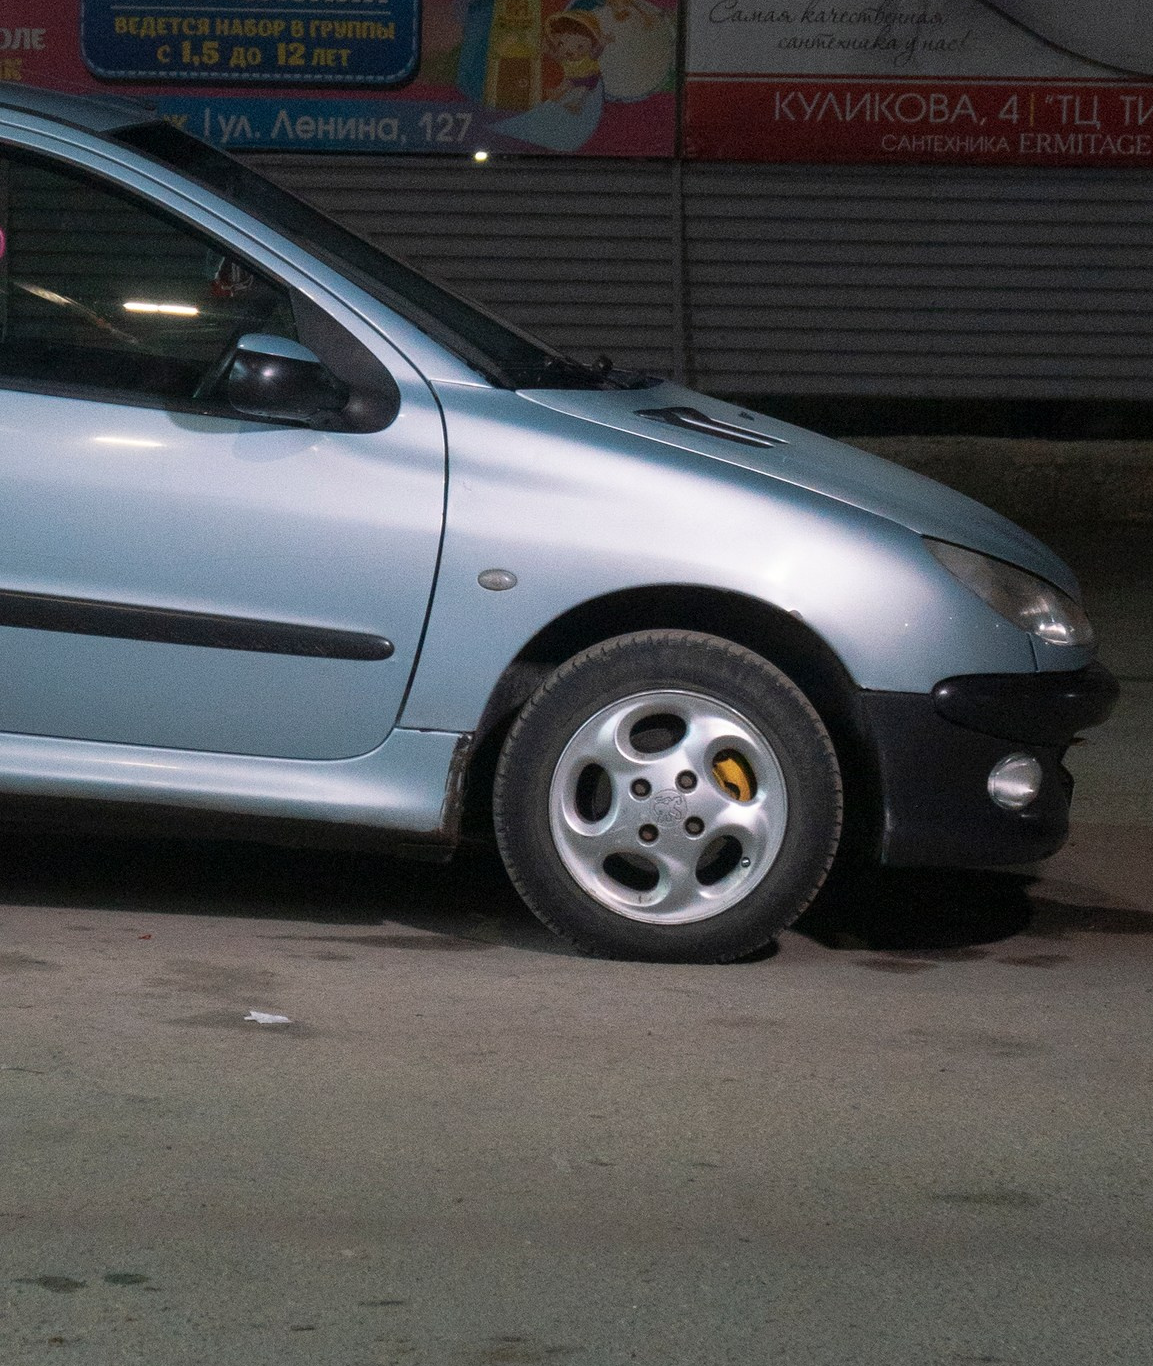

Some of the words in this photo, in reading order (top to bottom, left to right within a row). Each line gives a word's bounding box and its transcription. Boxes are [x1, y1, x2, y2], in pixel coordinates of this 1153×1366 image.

[114, 16, 211, 38] ВЕДЕТСЯ
[215, 18, 286, 37] НАБОР
[290, 19, 305, 37] В
[309, 20, 397, 40] ГРУППЫ
[181, 40, 221, 66] 1,5
[276, 41, 306, 66] 12
[777, 24, 897, 51] сантехника
[893, 34, 919, 68] у
[921, 29, 973, 53] нас!
[773, 91, 987, 126] КУЛИКОВА,
[996, 93, 1020, 124] 4
[217, 113, 261, 143] ул.
[269, 109, 408, 145] Ленина,
[418, 111, 473, 143] 127
[881, 134, 1011, 154] САНТЕХНИКА
[1018, 132, 1152, 156] ERMITAGE
